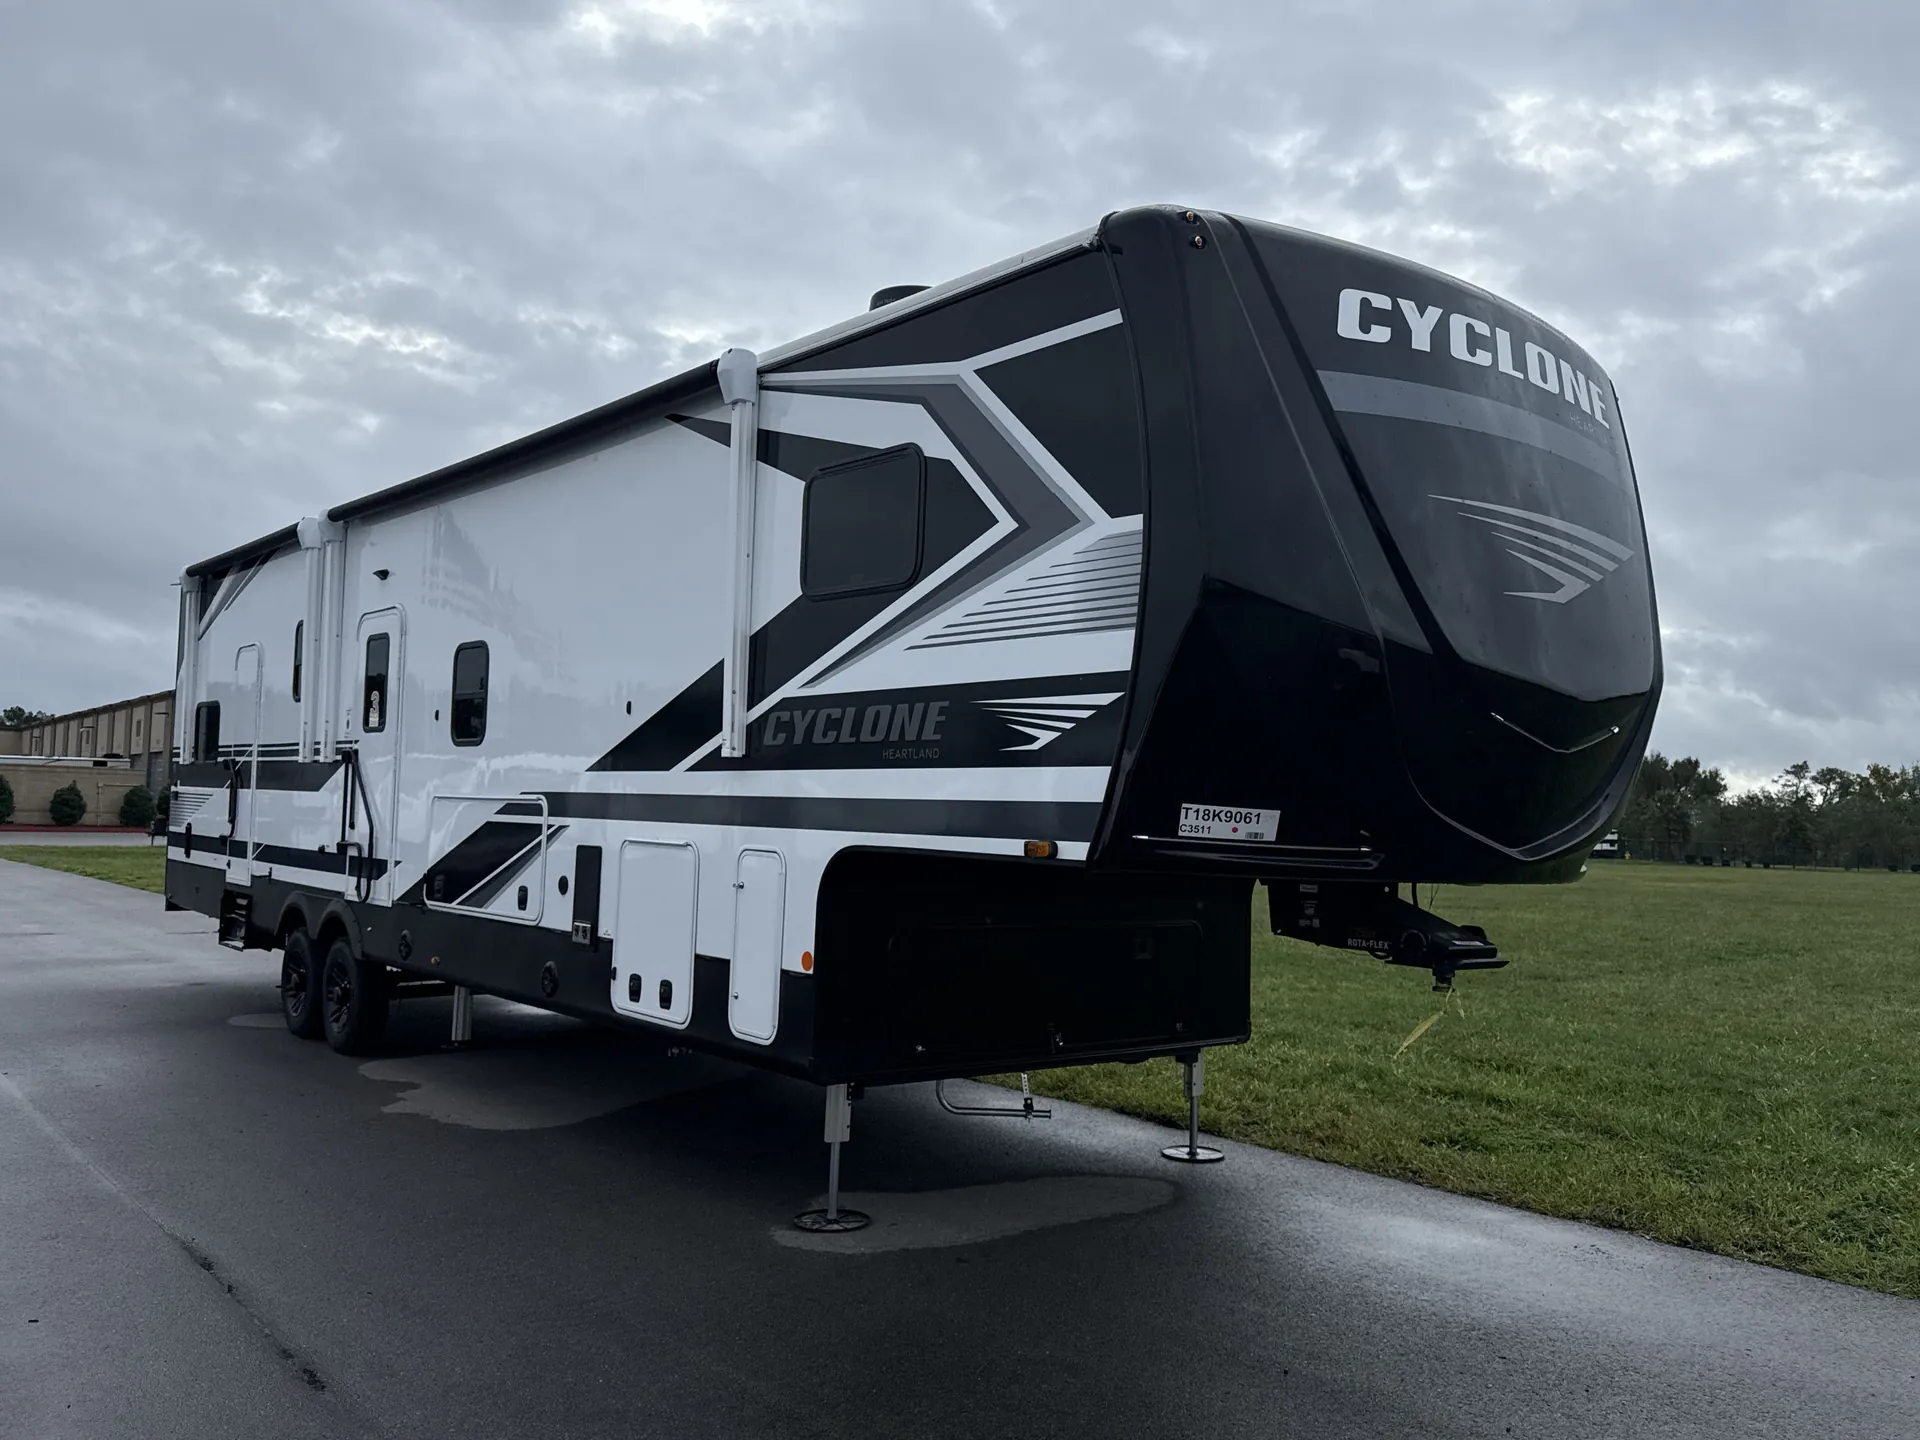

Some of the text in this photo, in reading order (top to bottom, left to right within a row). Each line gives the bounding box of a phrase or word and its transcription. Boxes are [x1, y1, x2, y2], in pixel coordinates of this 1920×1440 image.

[1337, 288, 1610, 429] CYCLONE
[763, 700, 949, 746] CYCLONE
[882, 747, 940, 760] HEARTLAND
[1182, 806, 1262, 825] T18K9061
[1179, 823, 1212, 835] C3511
